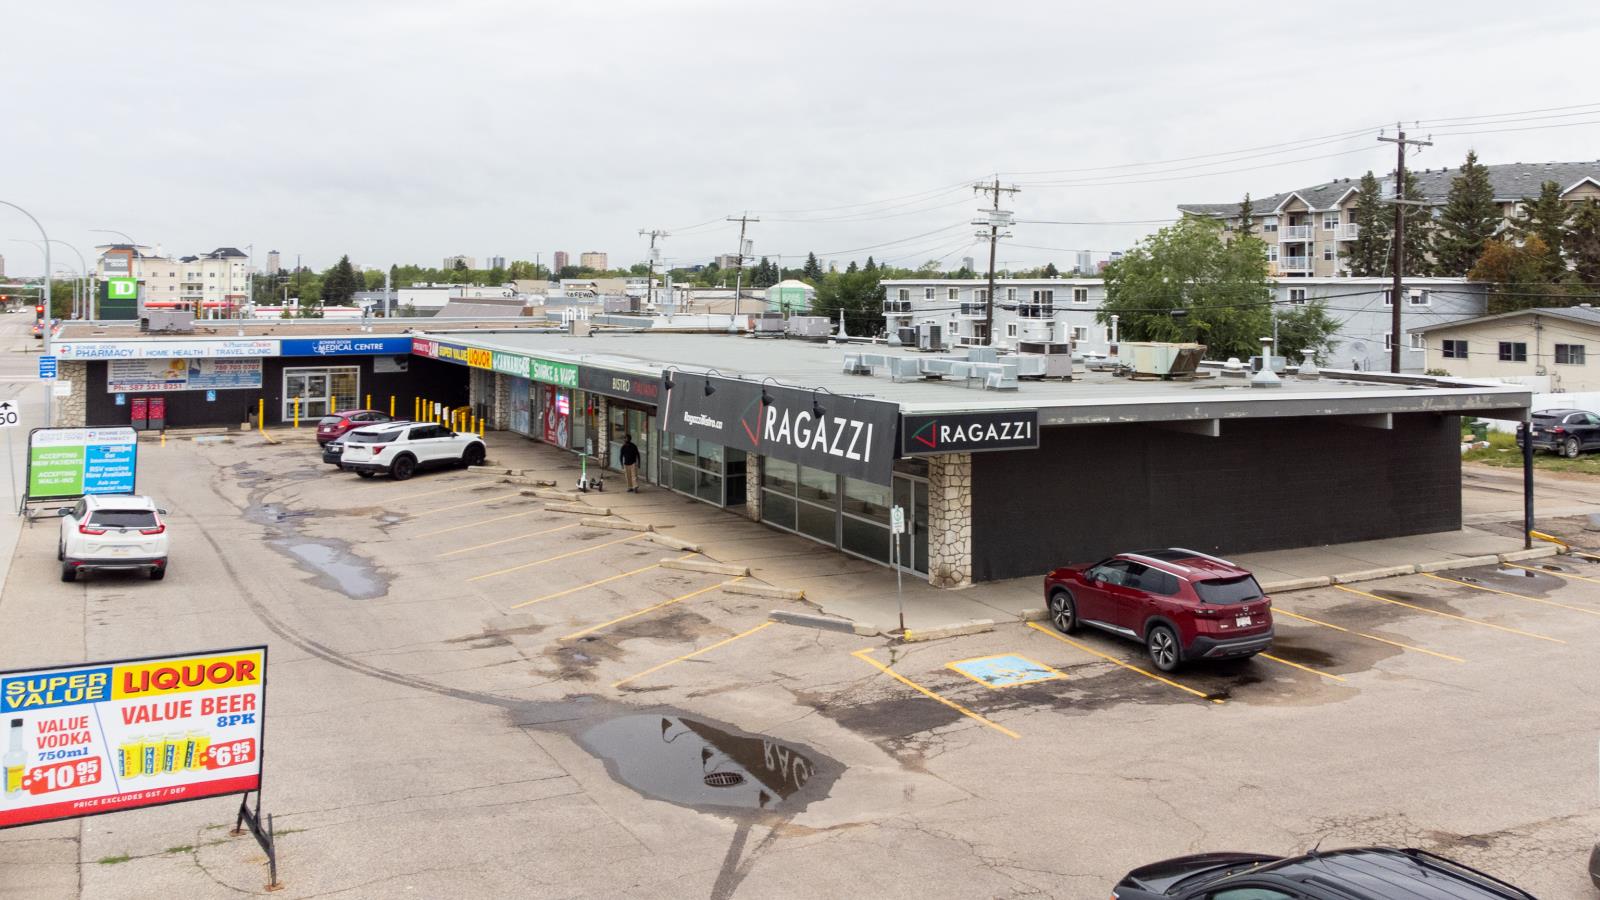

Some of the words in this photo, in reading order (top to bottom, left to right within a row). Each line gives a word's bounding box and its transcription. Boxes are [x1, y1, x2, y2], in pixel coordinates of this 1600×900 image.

[111, 281, 134, 295] TD
[76, 349, 134, 357] PHARMACY
[318, 343, 352, 352] MEDICAL
[354, 343, 383, 351] CENTRE
[468, 348, 491, 368] LIQUOR
[560, 367, 577, 386] VAPE
[612, 377, 631, 393] BISTRO
[764, 405, 874, 463] RAGAZZI
[940, 421, 1031, 443] RAGAZZI
[6, 673, 108, 695] SUPER
[123, 660, 256, 694] LIQUOR
[5, 686, 104, 708] VALUE
[121, 700, 193, 725] VALUE
[200, 693, 257, 716] BEER
[37, 716, 89, 734] VALUE
[216, 713, 256, 728] 8PK
[36, 731, 92, 749] VODKA
[38, 746, 89, 761] 750ml
[234, 754, 249, 763] EA
[79, 774, 96, 784] EA
[73, 800, 98, 809] PRICE
[101, 794, 143, 805] EXCLUDES
[146, 790, 161, 798] GST
[170, 786, 186, 795] DEP
